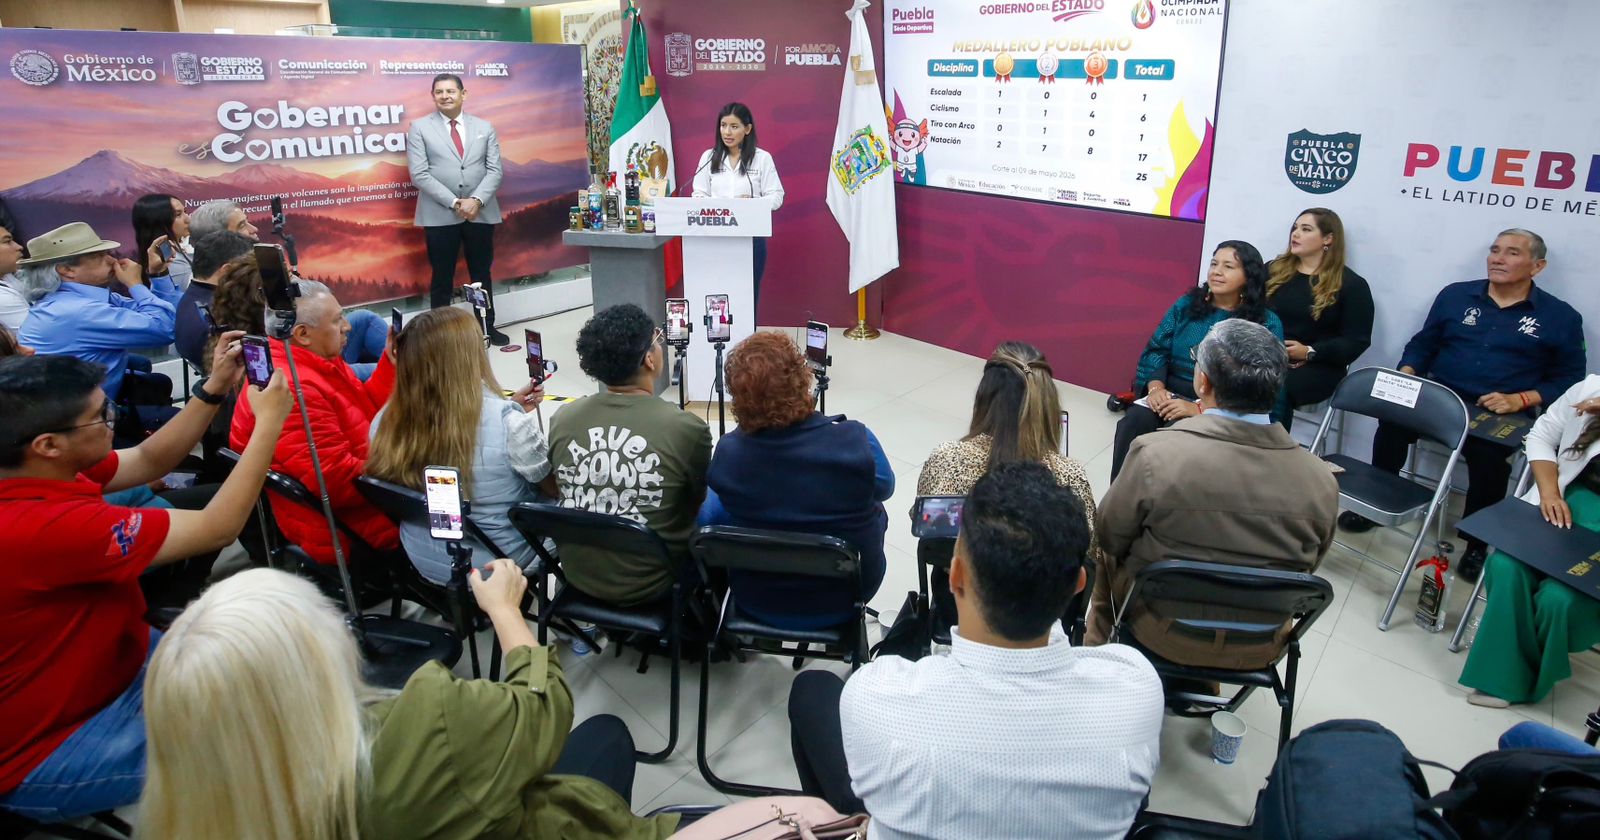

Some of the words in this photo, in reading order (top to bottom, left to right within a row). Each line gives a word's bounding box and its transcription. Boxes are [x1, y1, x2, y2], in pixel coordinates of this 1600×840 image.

[892, 6, 935, 21] Puebla
[979, 2, 1035, 15] GOBIERNO
[1036, 3, 1051, 11] DEL
[1051, 0, 1105, 12] ESTADO
[1160, 7, 1223, 17] NACIONAL
[907, 24, 933, 32] Deportiva
[695, 38, 766, 51] GOBIERNO
[799, 43, 837, 53] AMOR
[952, 39, 1041, 53] MEDALLERO
[1044, 36, 1132, 52] POBLANO
[63, 54, 133, 64] Gobierno
[137, 54, 154, 65] de
[200, 56, 262, 66] GOBIERNO
[278, 59, 367, 69] Comunicación
[695, 52, 710, 60] DEL
[711, 51, 766, 63] ESTADO
[785, 54, 842, 66] PUEBLA
[216, 66, 264, 75] ESTADO
[380, 60, 465, 71] Representación
[933, 62, 974, 74] Disciplina
[1134, 64, 1165, 76] Total
[65, 64, 157, 82] México
[930, 88, 962, 97] Escalada
[998, 90, 1002, 98] 1
[1044, 91, 1050, 100] 0
[1090, 92, 1097, 100] 0
[1142, 93, 1147, 102] 1
[217, 100, 404, 131] Gobernar
[930, 104, 959, 112] Ciclismo
[998, 107, 1002, 115] 1
[1043, 109, 1048, 117] 1
[1089, 110, 1095, 119] 4
[1140, 113, 1147, 122] 6
[930, 120, 943, 128] Tiro
[944, 121, 957, 129] con
[958, 121, 975, 130] Arco
[997, 124, 1003, 132] 0
[1088, 128, 1095, 137] 0
[1139, 133, 1144, 142] 1
[178, 141, 213, 160] es
[211, 127, 409, 163] Comunica
[930, 135, 962, 145] Natación
[996, 141, 1002, 149] 2
[1042, 144, 1047, 152] 7
[1087, 147, 1093, 155] 8
[1138, 153, 1148, 162] 17
[1300, 139, 1345, 149] PUEBLA
[1290, 147, 1353, 165] CINCO
[992, 164, 1010, 173] Corte
[1010, 165, 1018, 174] al
[1018, 166, 1027, 174] 09
[1028, 167, 1037, 175] de
[1038, 169, 1058, 179] mayo
[1136, 172, 1148, 181] 25
[1288, 164, 1299, 172] DE
[1297, 163, 1349, 181] MAYO
[291, 188, 329, 198] volcanes
[331, 186, 346, 194] son
[347, 185, 356, 193] la
[357, 181, 401, 193] inspiración
[242, 202, 288, 213] recuern
[290, 199, 298, 209] el
[300, 196, 335, 208] llamado
[336, 197, 352, 206] que
[353, 193, 387, 203] tenemos
[394, 190, 402, 198] la
[1412, 186, 1433, 200] EL
[1442, 189, 1516, 208] LATIDO
[1525, 196, 1554, 212] DE
[1563, 199, 1600, 216] MÉ
[699, 208, 730, 217] AMOR
[687, 216, 739, 227] PUEBLA
